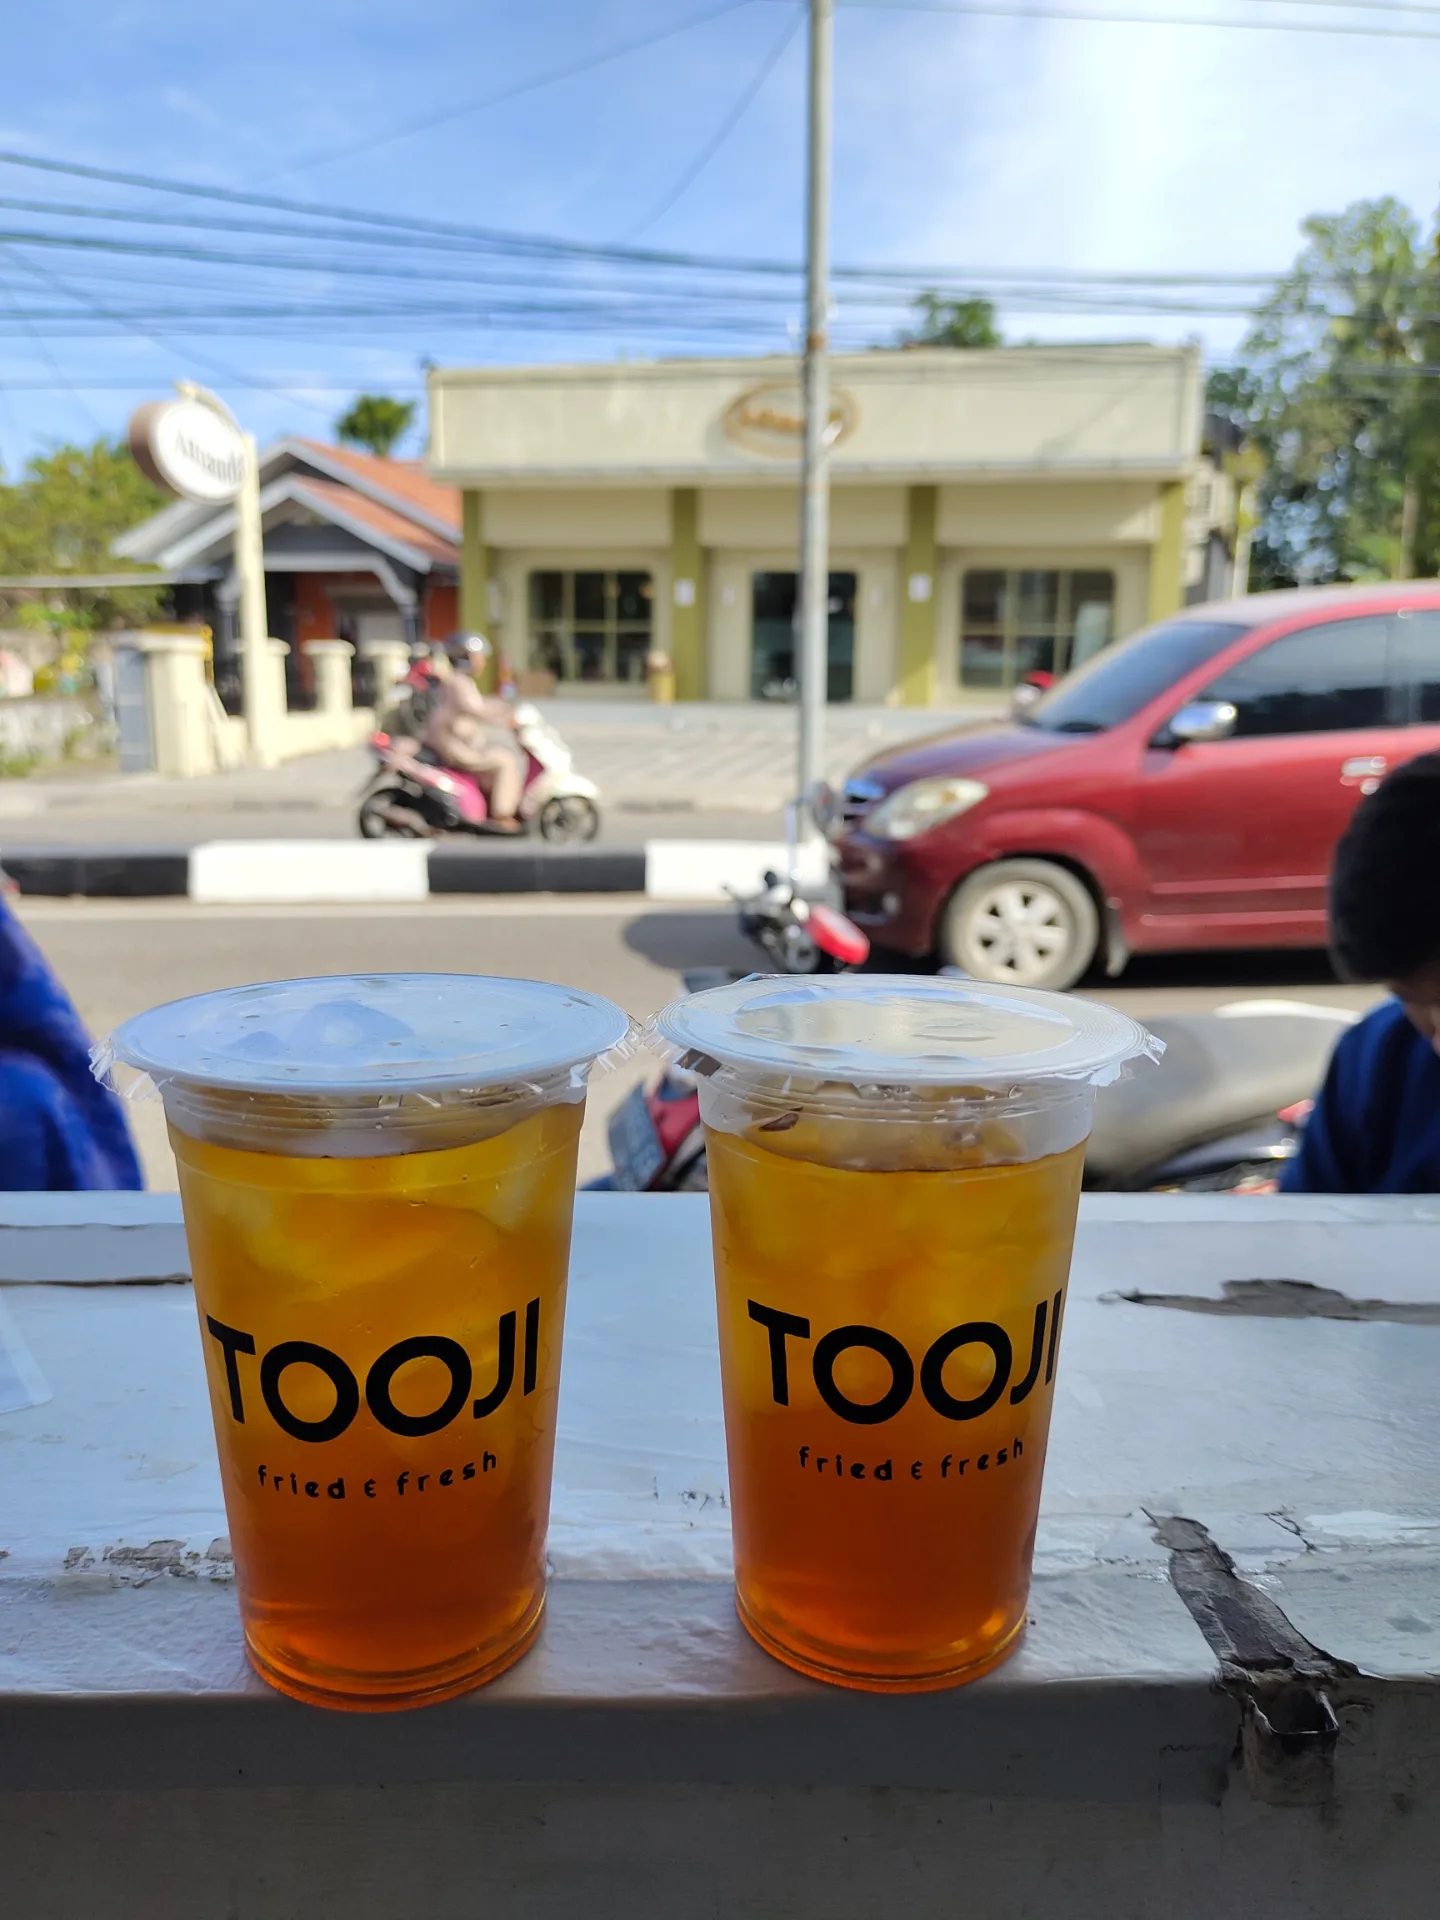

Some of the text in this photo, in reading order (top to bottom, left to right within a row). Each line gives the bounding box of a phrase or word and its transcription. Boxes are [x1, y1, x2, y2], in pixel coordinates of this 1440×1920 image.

[206, 1297, 540, 1442] TOOJI
[747, 1288, 1063, 1424] TOOJI
[258, 1464, 345, 1499] fried
[397, 1451, 498, 1495] fresh
[799, 1446, 892, 1481] fried
[941, 1437, 1023, 1478] fresh
